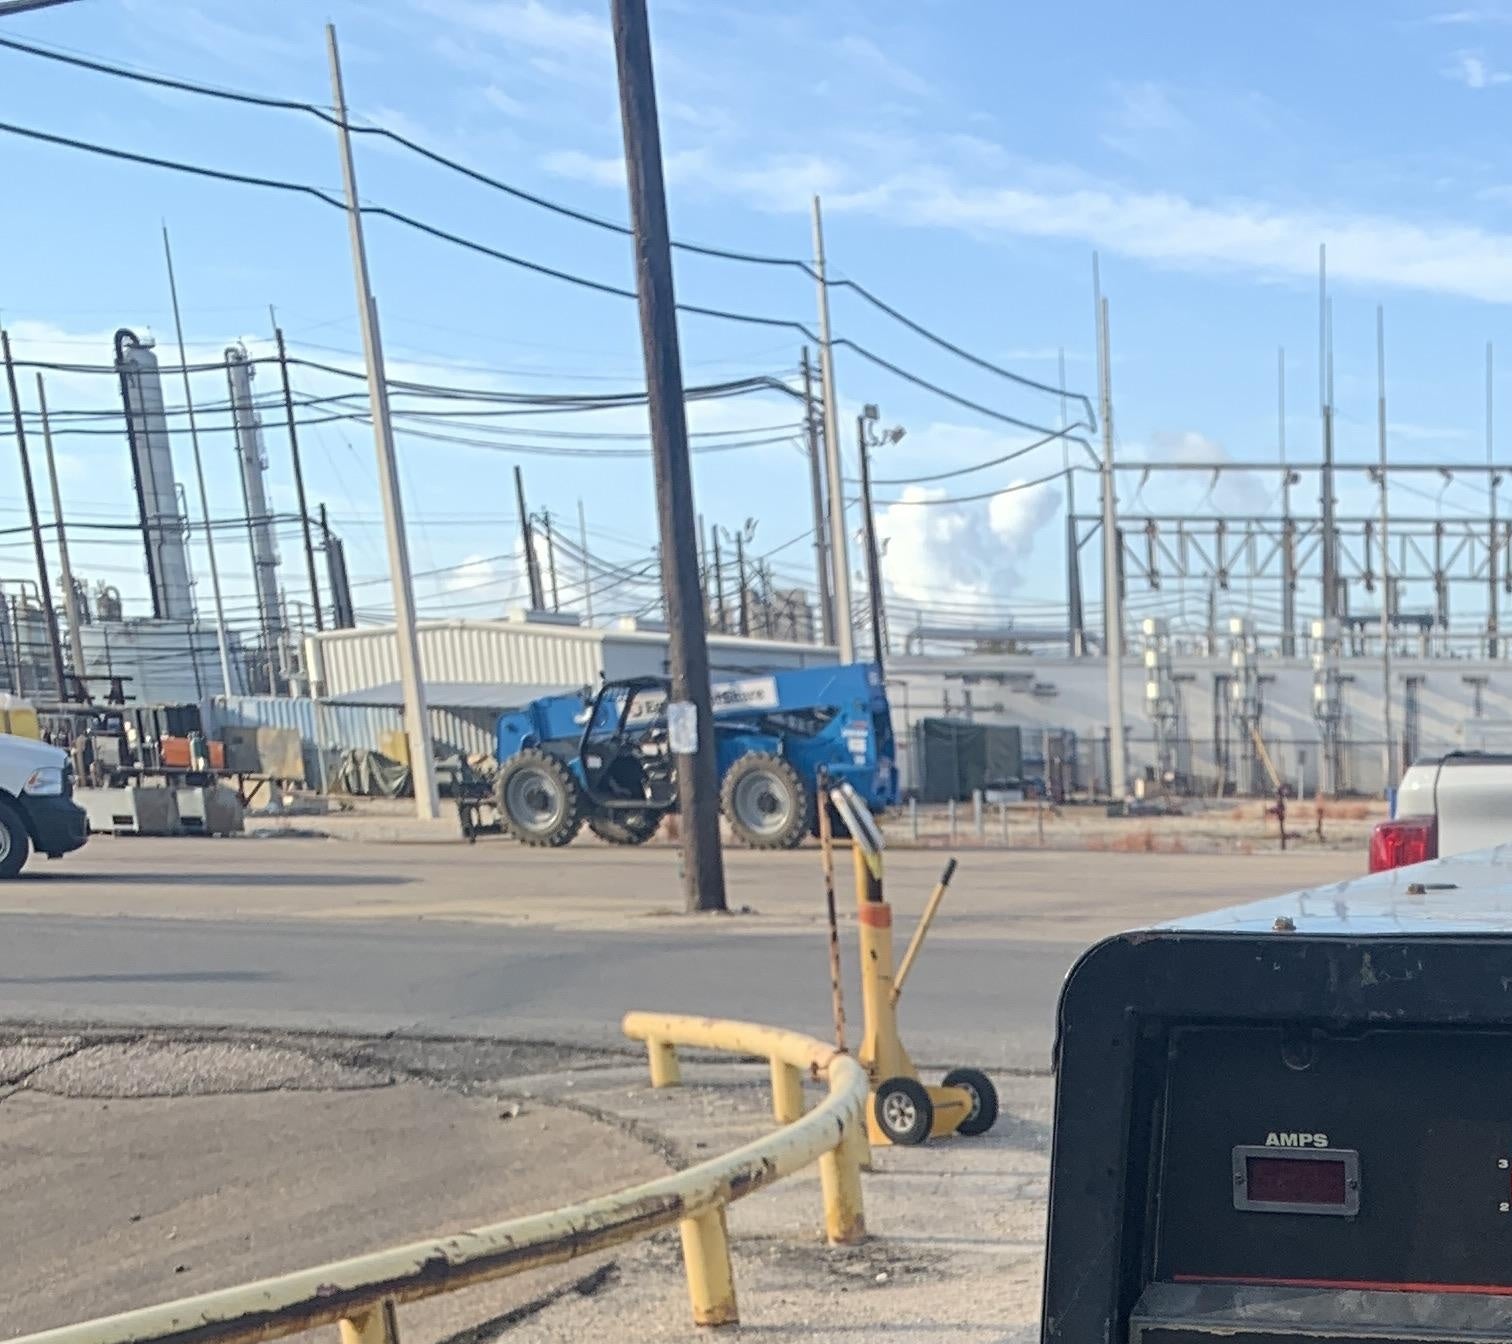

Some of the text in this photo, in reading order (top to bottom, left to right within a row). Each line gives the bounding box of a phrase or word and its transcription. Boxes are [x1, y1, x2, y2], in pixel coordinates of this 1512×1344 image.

[1265, 1132, 1329, 1148] AMPS
[1498, 1159, 1508, 1169] 3
[1499, 1202, 1509, 1212] 2
